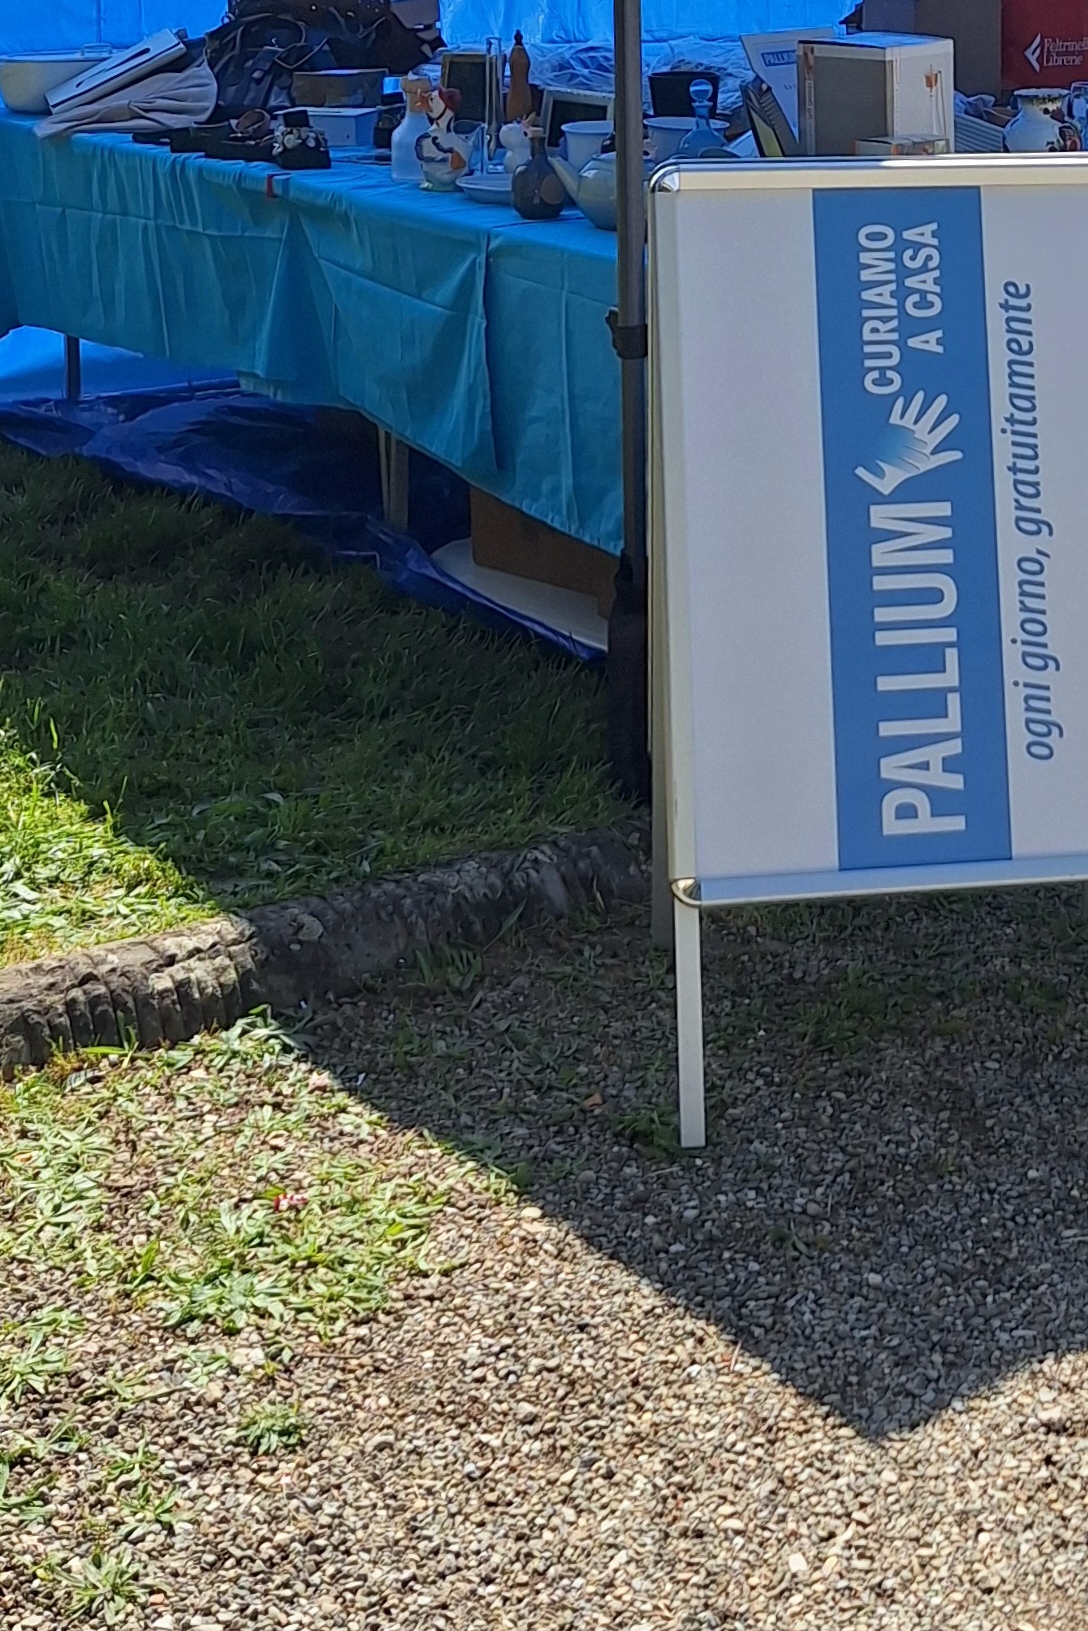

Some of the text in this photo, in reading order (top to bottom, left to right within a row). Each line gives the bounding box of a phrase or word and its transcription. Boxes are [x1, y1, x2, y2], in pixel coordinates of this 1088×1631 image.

[1043, 51, 1083, 67] Librerie
[857, 223, 902, 395] CURIAMO
[902, 222, 944, 354] A CASA
[997, 279, 1064, 761] ogni giorno, gratuitamente
[869, 501, 967, 837] PALLIUM
